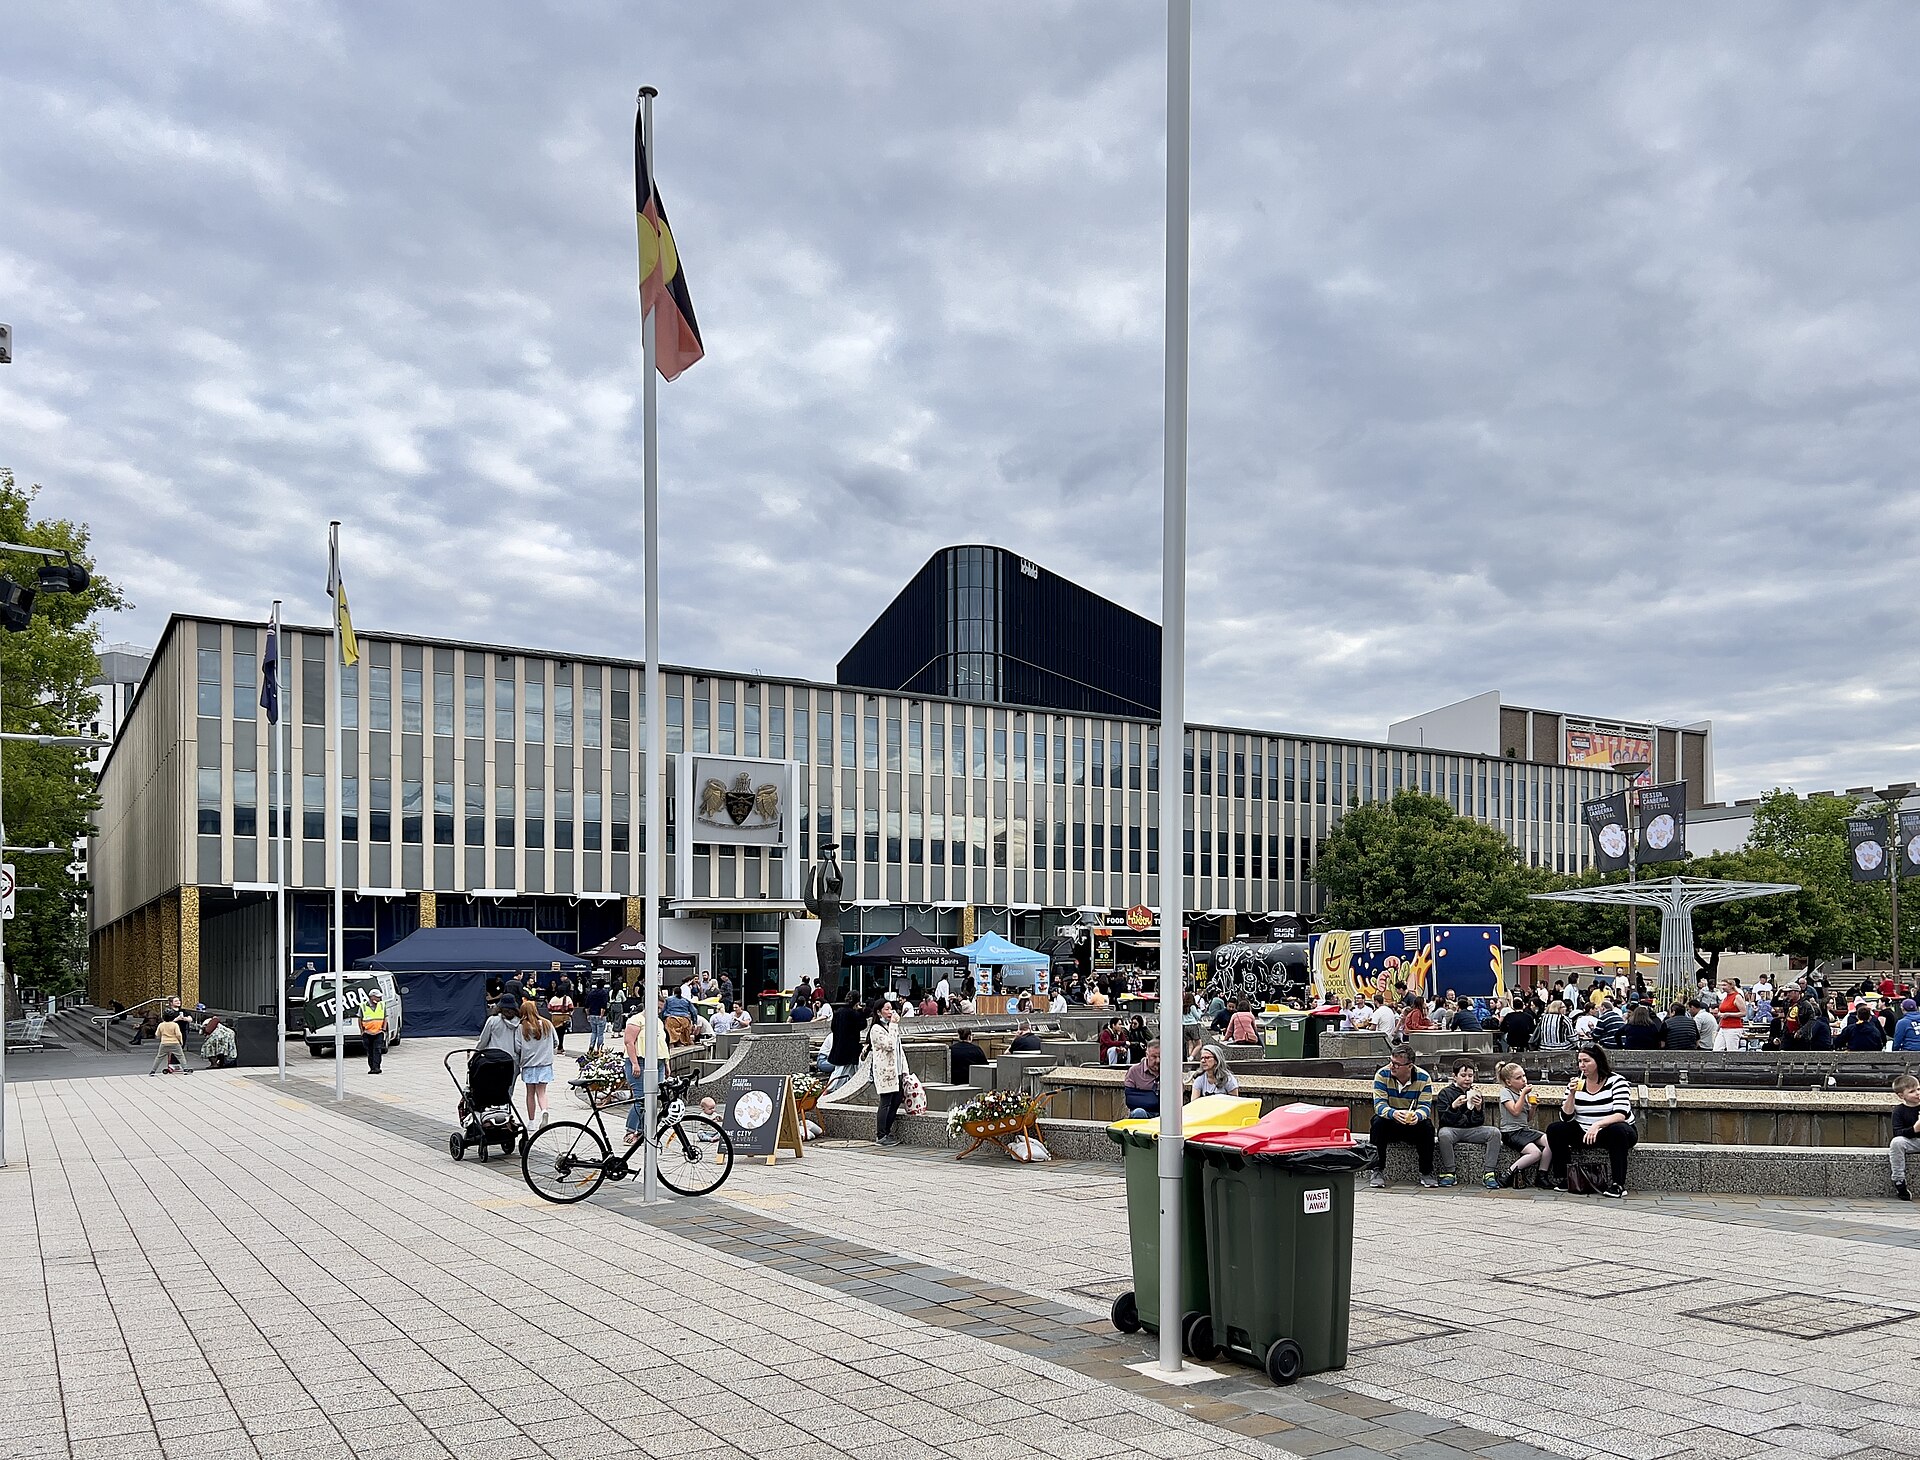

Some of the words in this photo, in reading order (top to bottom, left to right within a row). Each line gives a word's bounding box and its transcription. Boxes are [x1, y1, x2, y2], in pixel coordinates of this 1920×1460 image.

[1569, 753, 1585, 762] THE
[1641, 791, 1663, 799] DESIGN
[1642, 796, 1669, 805] CANBERRA
[1587, 803, 1607, 812] DESIGN
[1589, 806, 1614, 817] CANBERRA
[901, 957, 940, 965] Handcrafted
[941, 957, 959, 966] Spirits
[1305, 1191, 1329, 1201] WASTE
[1308, 1202, 1327, 1211] AWAY
